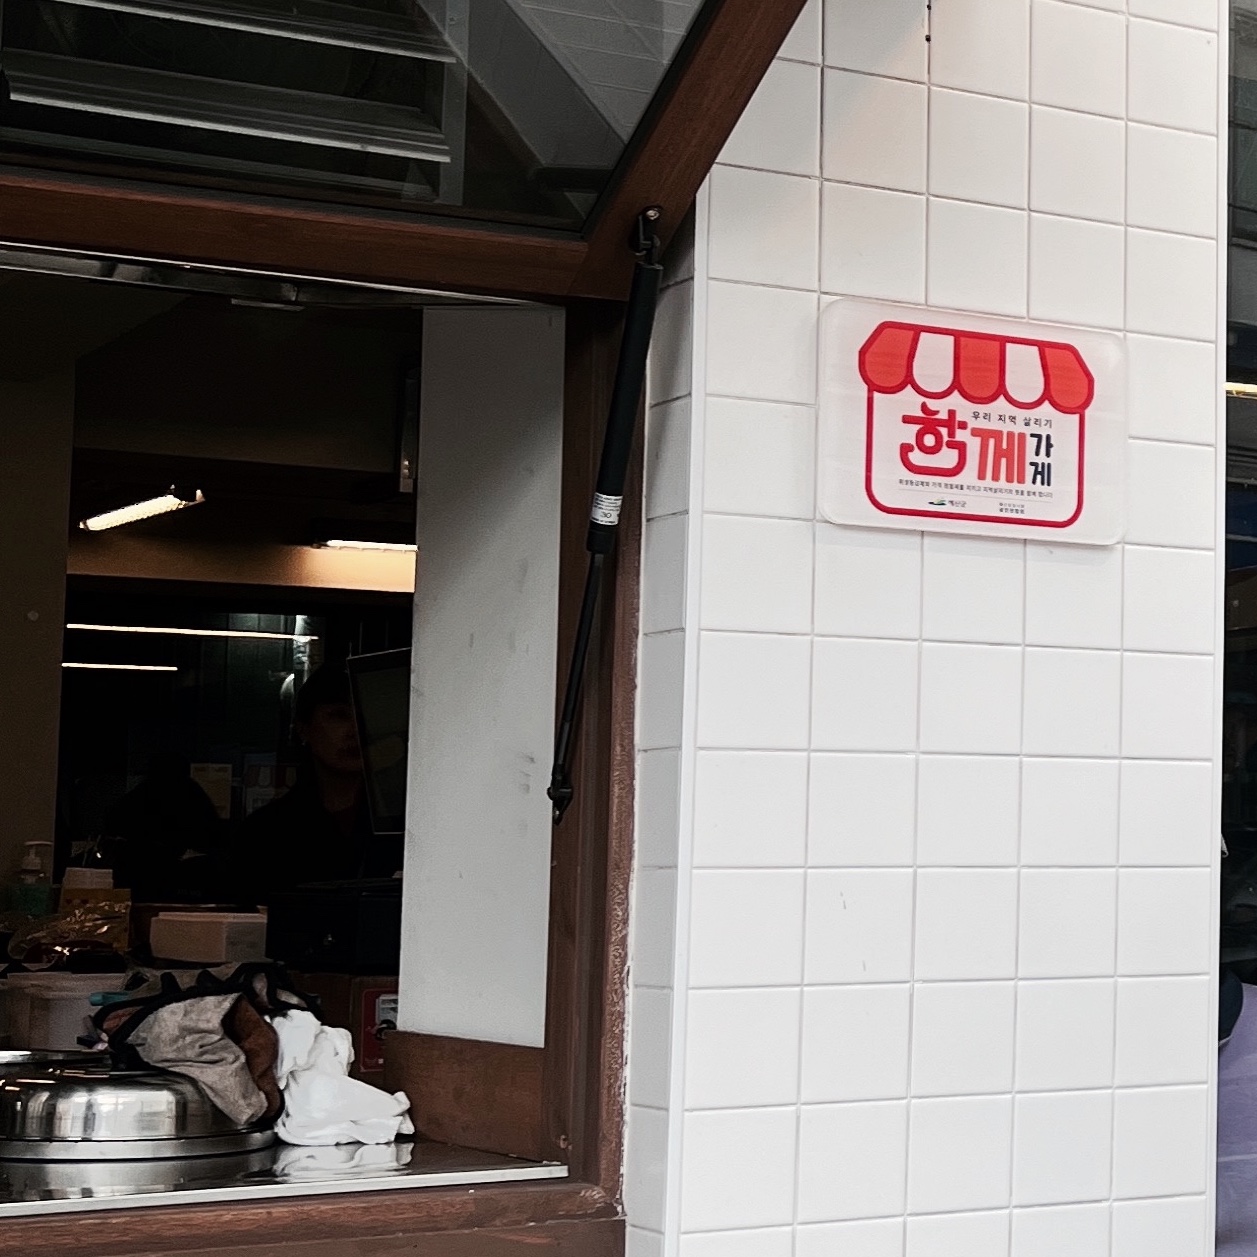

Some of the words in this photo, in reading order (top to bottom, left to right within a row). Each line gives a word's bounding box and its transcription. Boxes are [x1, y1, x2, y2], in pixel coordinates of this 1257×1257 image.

[900, 401, 1026, 484] 함께
[971, 411, 992, 422] 우리
[997, 414, 1017, 426] 지역
[1023, 416, 1053, 429] 살리기
